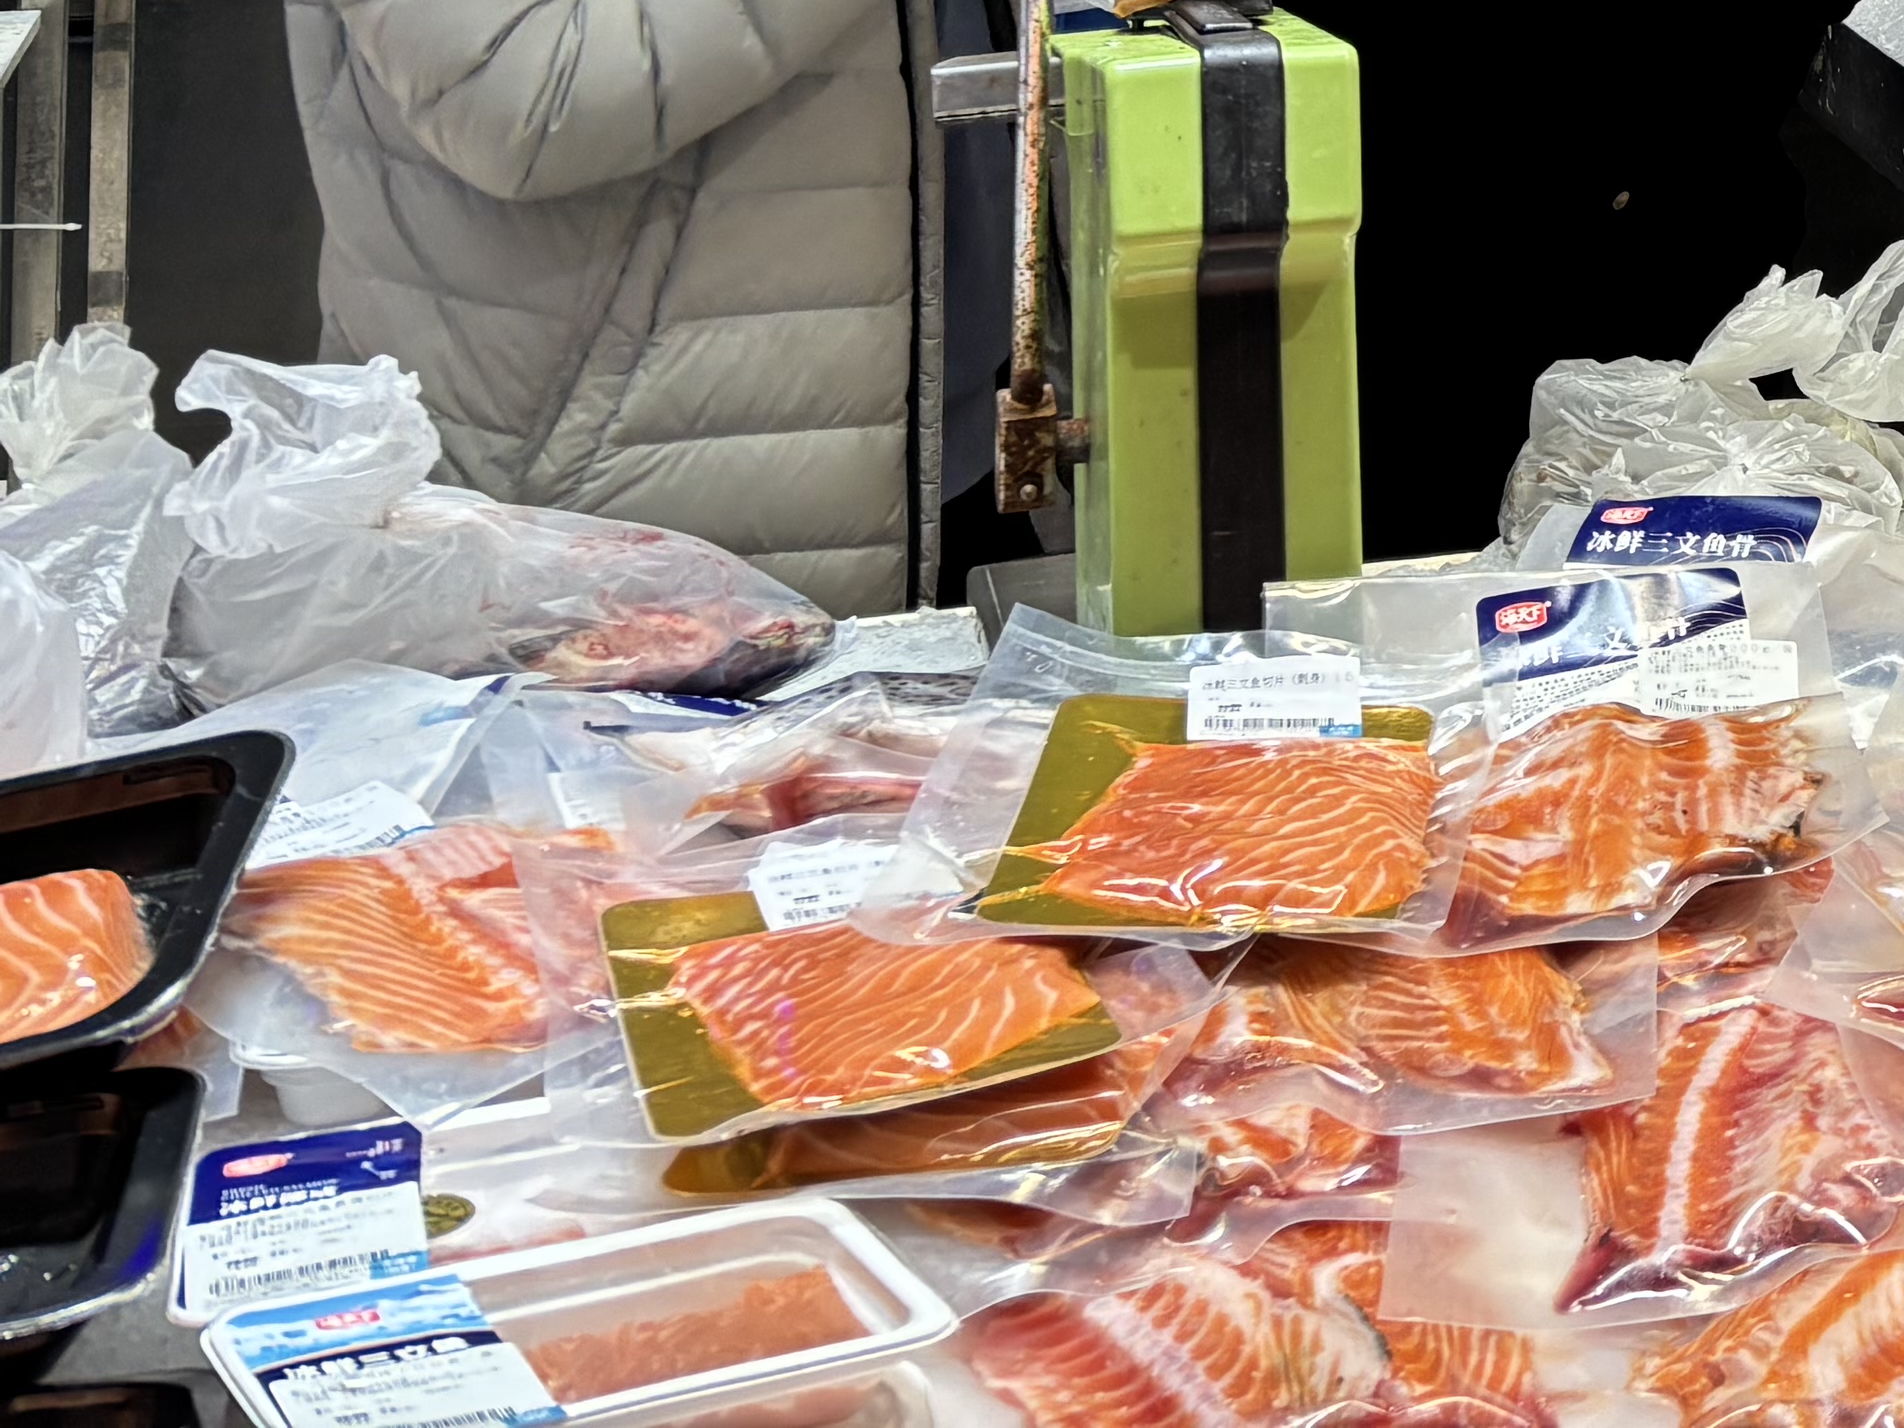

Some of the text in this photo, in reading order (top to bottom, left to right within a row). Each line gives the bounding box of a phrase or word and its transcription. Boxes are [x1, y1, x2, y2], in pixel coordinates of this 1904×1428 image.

[1586, 529, 1757, 559] 冰鲜三文鱼骨
